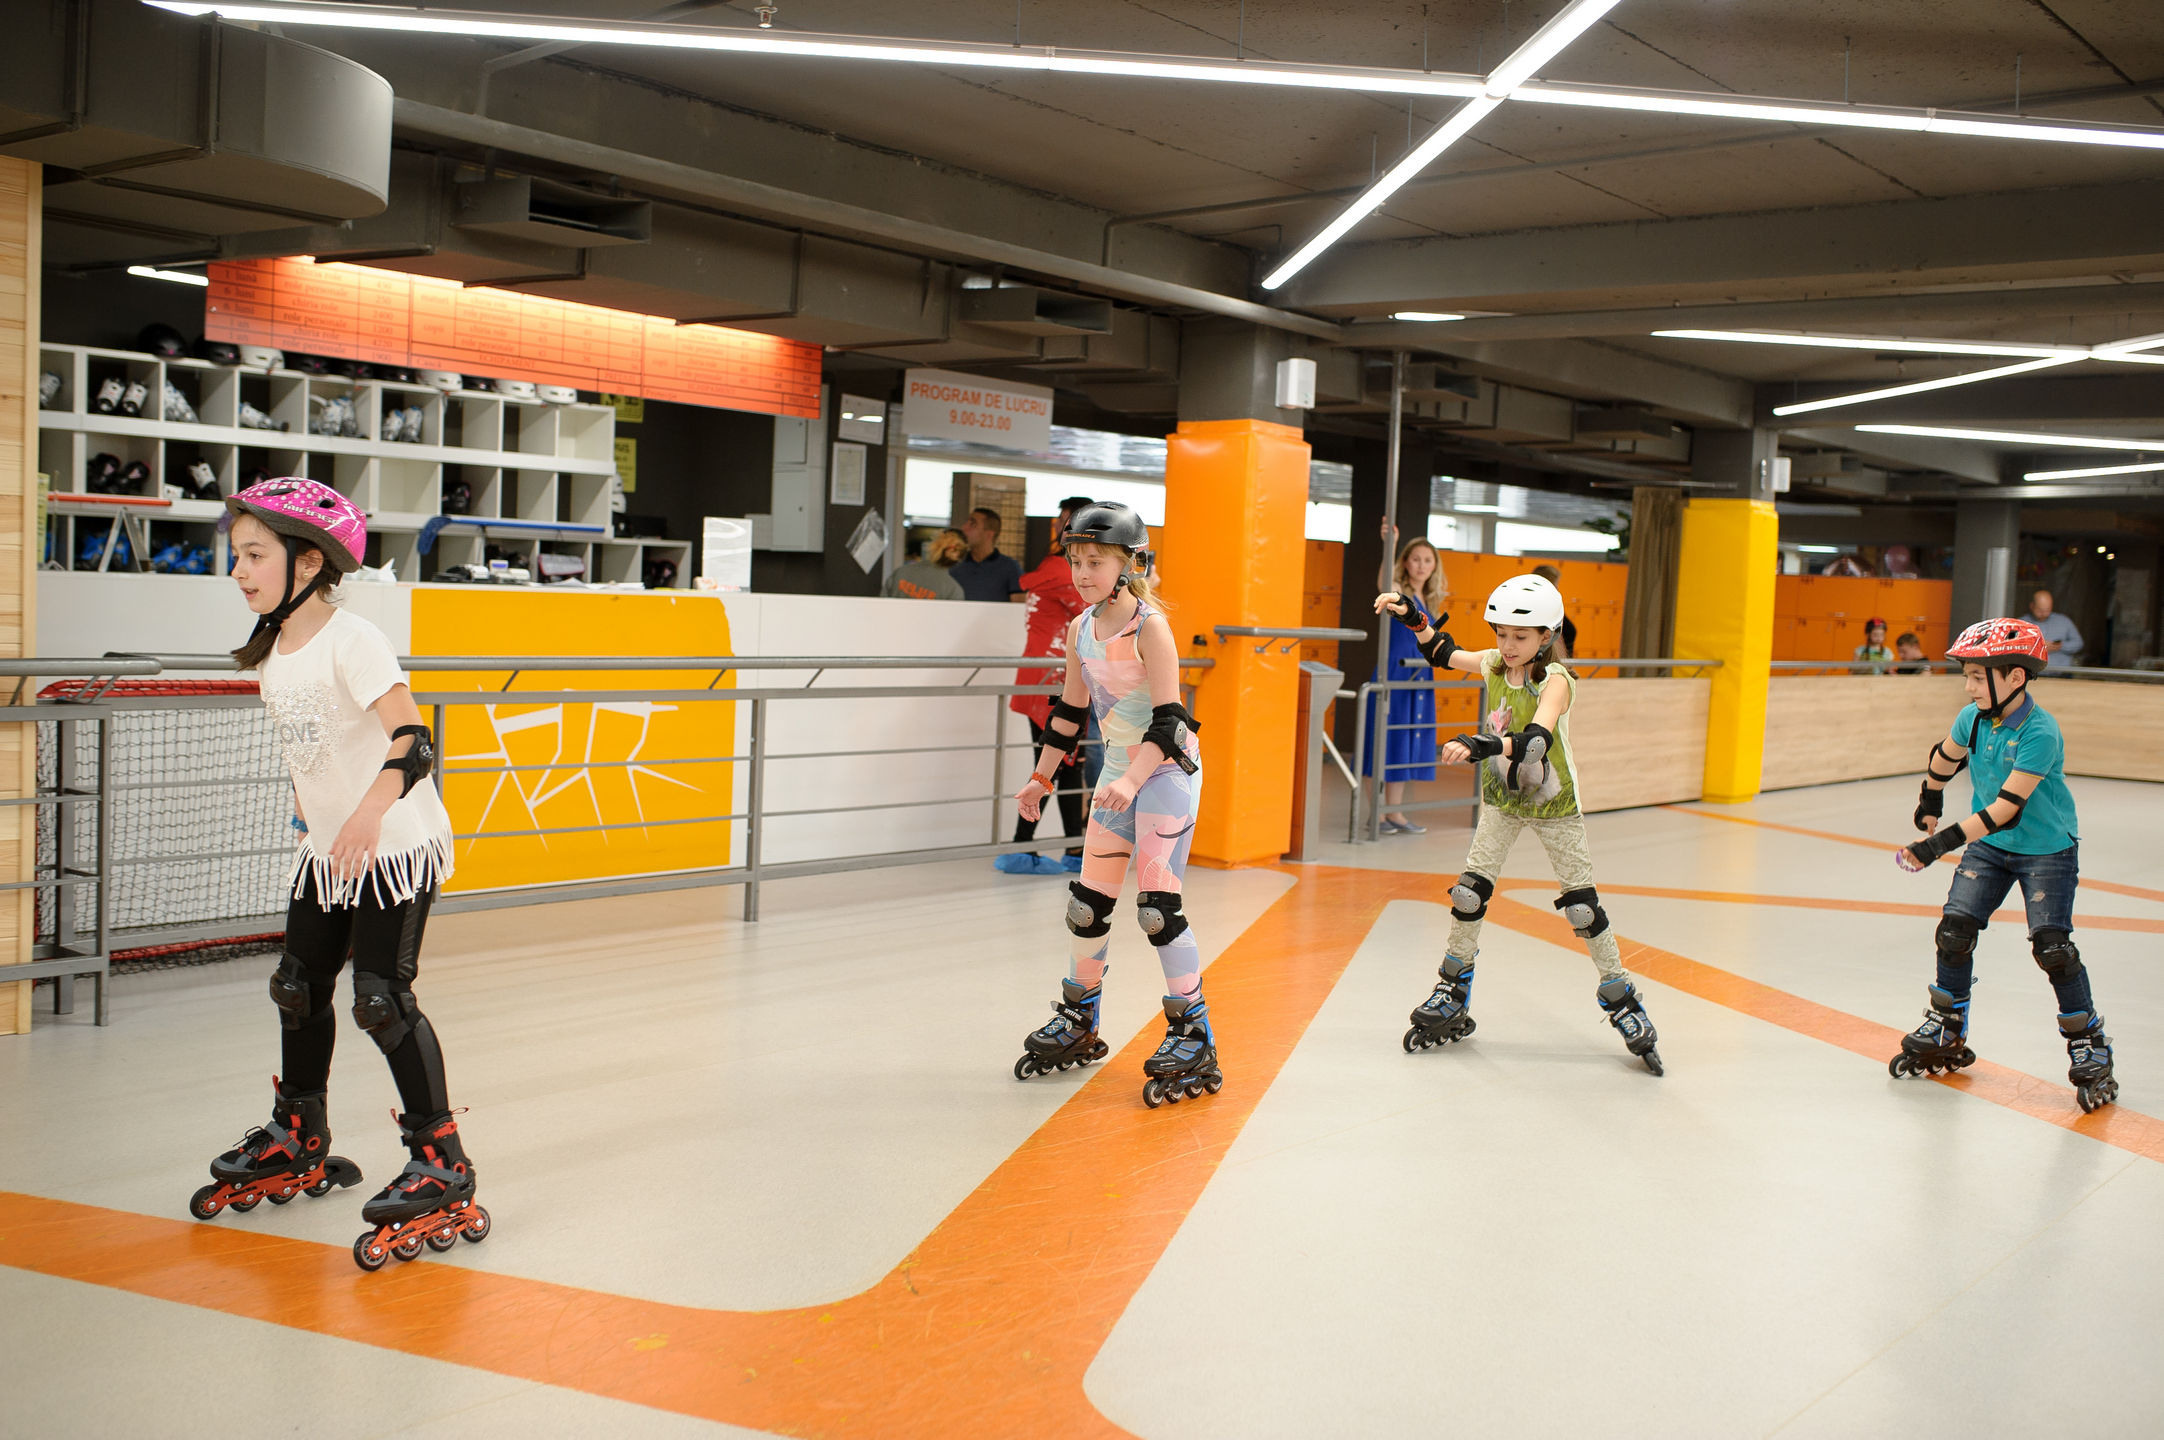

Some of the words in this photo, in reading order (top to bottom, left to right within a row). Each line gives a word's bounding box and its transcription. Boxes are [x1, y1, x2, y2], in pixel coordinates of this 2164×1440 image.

[910, 381, 981, 406] PROGRAM
[984, 393, 1003, 409] DE
[1005, 396, 1047, 416] LUCRU
[950, 409, 1012, 431] 9.00-23.00
[279, 722, 321, 744] OVE
